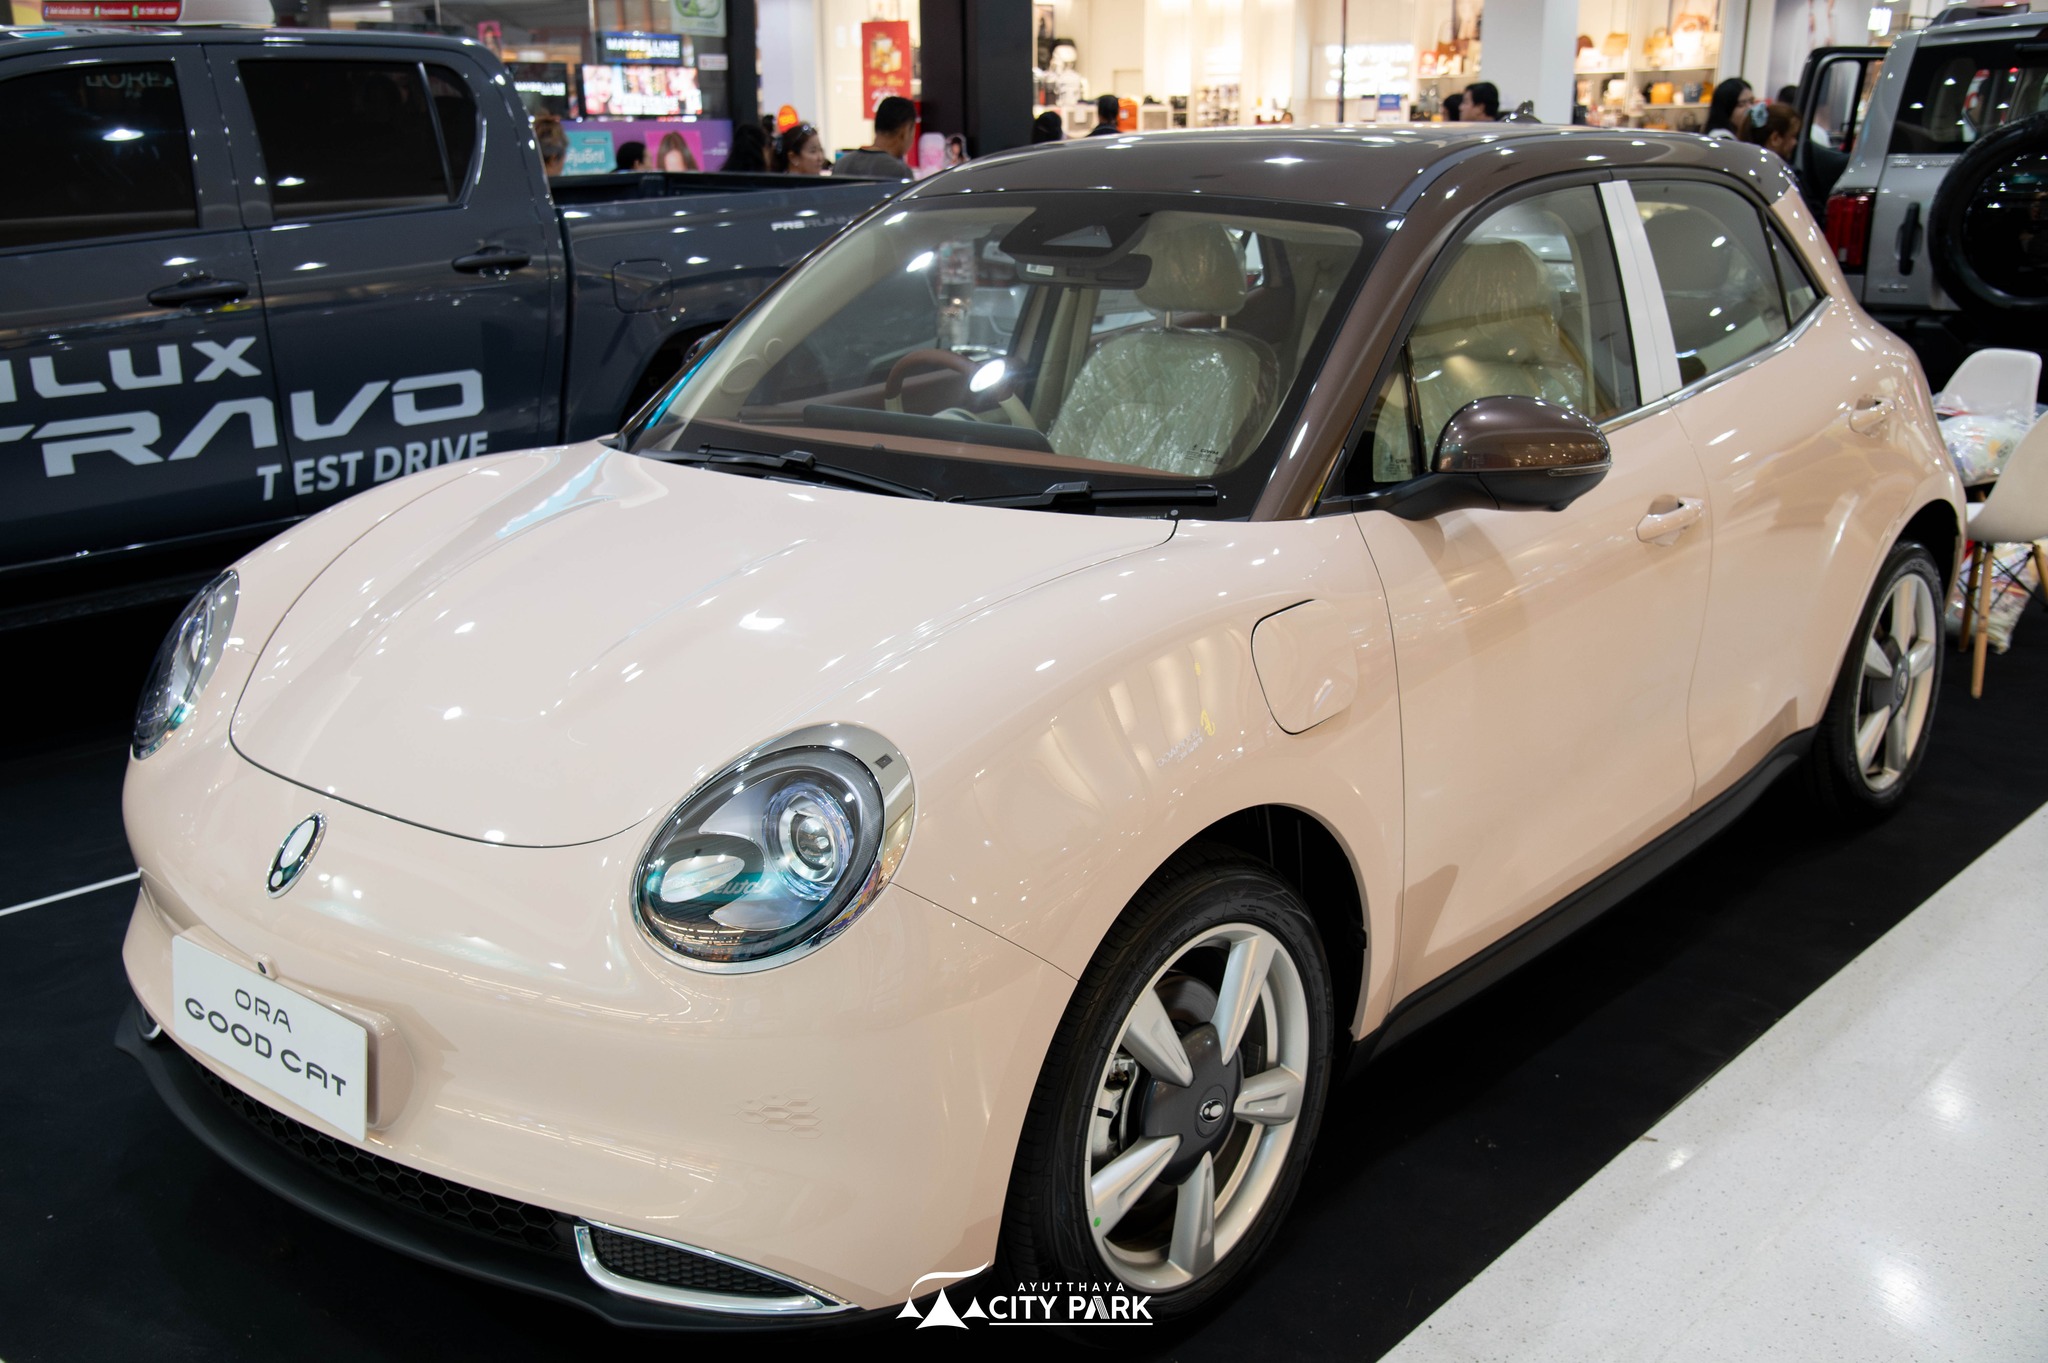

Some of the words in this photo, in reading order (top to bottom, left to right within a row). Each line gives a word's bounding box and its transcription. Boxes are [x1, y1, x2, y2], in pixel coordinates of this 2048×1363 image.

[373, 431, 488, 482] DRIVE
[235, 988, 292, 1033] ORA
[185, 997, 272, 1059] GOOD
[280, 1049, 347, 1097] CAT
